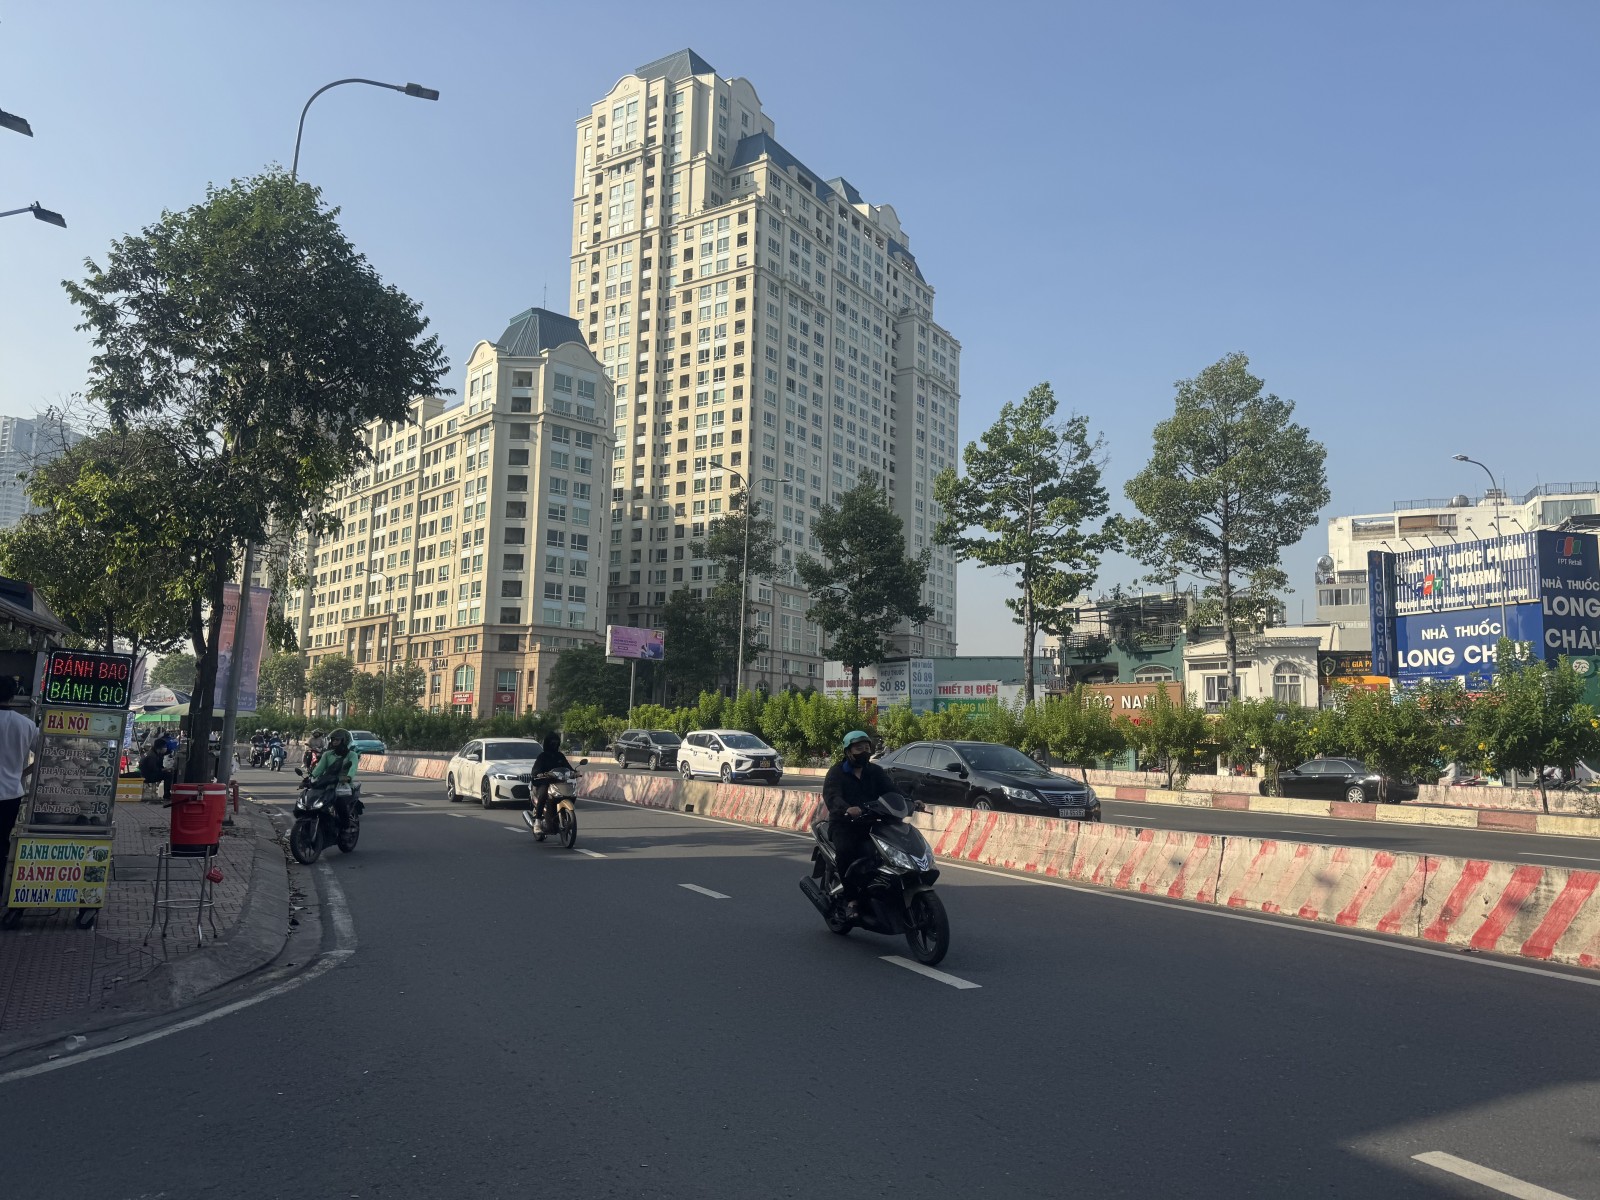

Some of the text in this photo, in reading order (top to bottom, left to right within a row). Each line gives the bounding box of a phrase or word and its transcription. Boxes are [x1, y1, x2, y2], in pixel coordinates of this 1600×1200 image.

[1426, 556, 1443, 571] TY
[1450, 569, 1506, 589] PHARMA
[1541, 576, 1600, 591] NHÀ THUỐC
[1542, 595, 1600, 618] LONG
[1421, 618, 1502, 640] NHÀ THUỐC
[1544, 625, 1600, 650] CHÂU
[1397, 641, 1530, 668] LONG CHU
[53, 655, 128, 680] BÁNH BAO
[1351, 660, 1364, 669] GIA
[880, 676, 891, 692] SỐ
[894, 680, 906, 692] 89
[923, 672, 933, 682] 89
[50, 678, 124, 704] BÁNH GIÒ
[938, 682, 998, 696] THIẾT BỊ ĐIỆN
[47, 712, 90, 733] HÀ NỘI
[99, 748, 117, 759] 25
[97, 766, 114, 778] 20
[95, 785, 112, 796] 17
[92, 802, 108, 815] 13
[20, 841, 50, 860] BÁNH
[17, 862, 81, 881] BÁNH GIÒ
[14, 884, 30, 902] XÔI
[31, 885, 50, 905] MẶN
[55, 884, 79, 902] KHÚC
